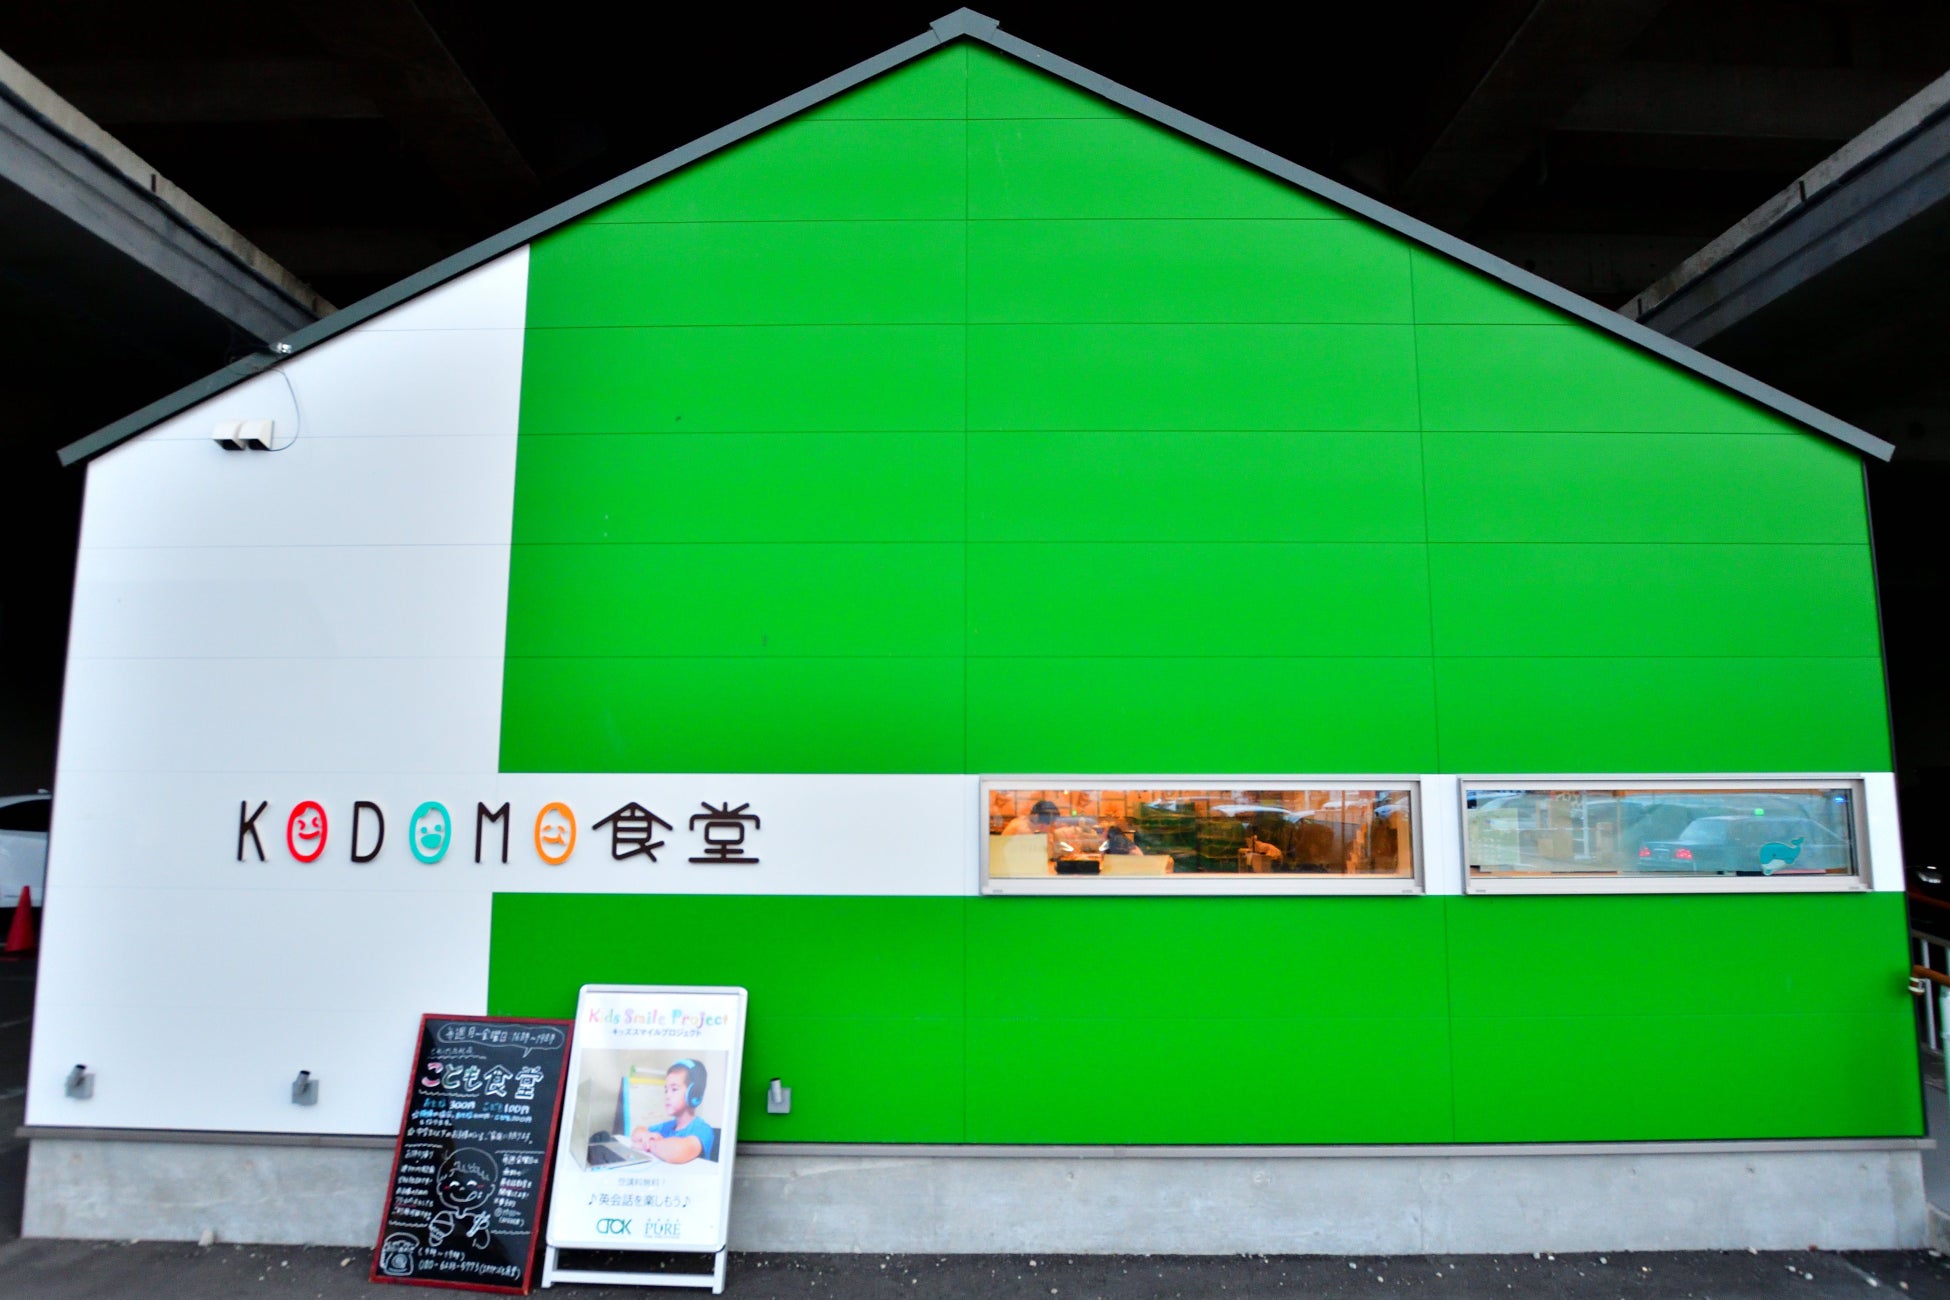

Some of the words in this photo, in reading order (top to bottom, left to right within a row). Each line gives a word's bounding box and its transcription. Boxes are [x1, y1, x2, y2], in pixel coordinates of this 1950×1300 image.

[588, 1008, 621, 1025] Kids
[624, 1008, 666, 1026] Smile
[671, 1009, 729, 1029] Project
[612, 1028, 702, 1038] キッズスマイルプロジェクト
[421, 1061, 545, 1100] こども食堂
[645, 1222, 681, 1236] PURE
